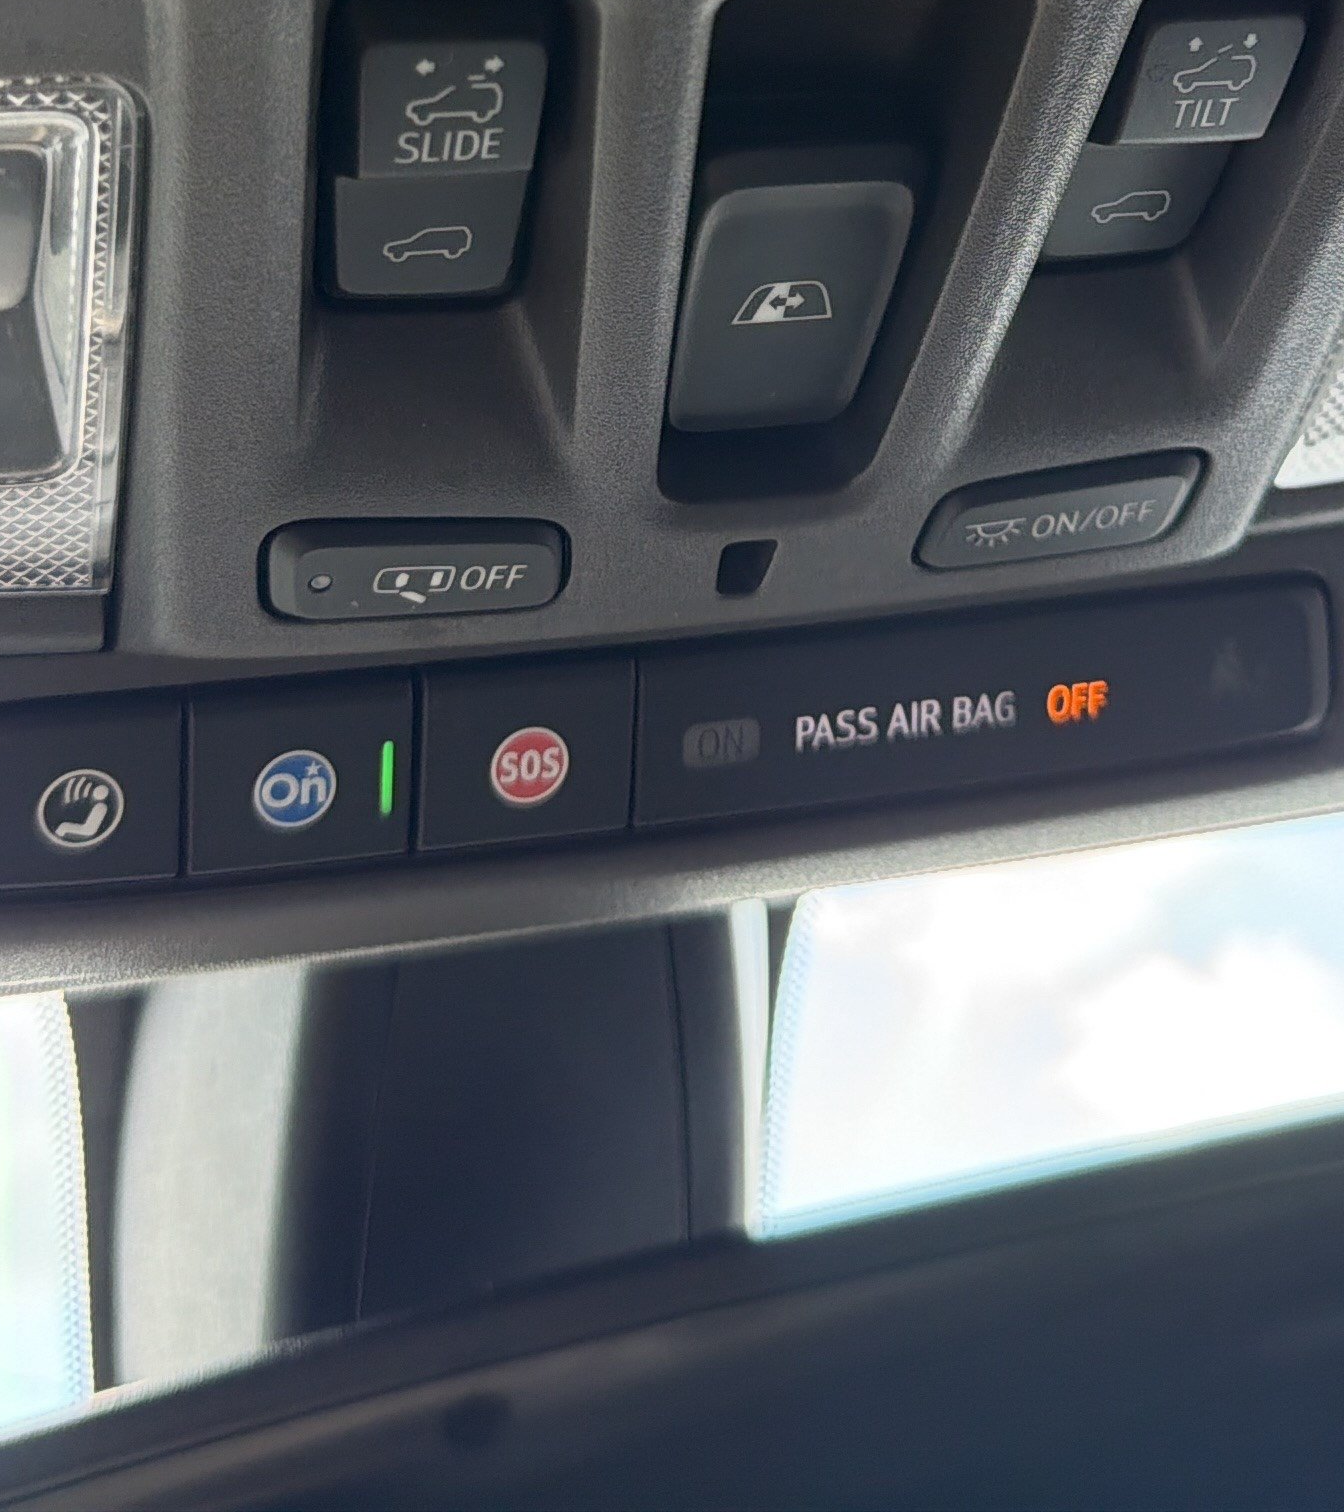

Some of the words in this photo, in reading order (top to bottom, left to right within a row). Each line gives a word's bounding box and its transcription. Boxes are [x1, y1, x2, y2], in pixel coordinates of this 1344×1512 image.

[1173, 96, 1240, 129] TILT
[393, 127, 505, 165] SLIDE
[1031, 499, 1157, 539] ON/OFF
[460, 563, 528, 591] OFF
[794, 705, 879, 753] PASS
[886, 696, 942, 741] AIR
[952, 689, 1017, 731] BAG
[1046, 679, 1110, 725] OFF
[500, 746, 561, 783] SOS
[260, 771, 328, 807] On
